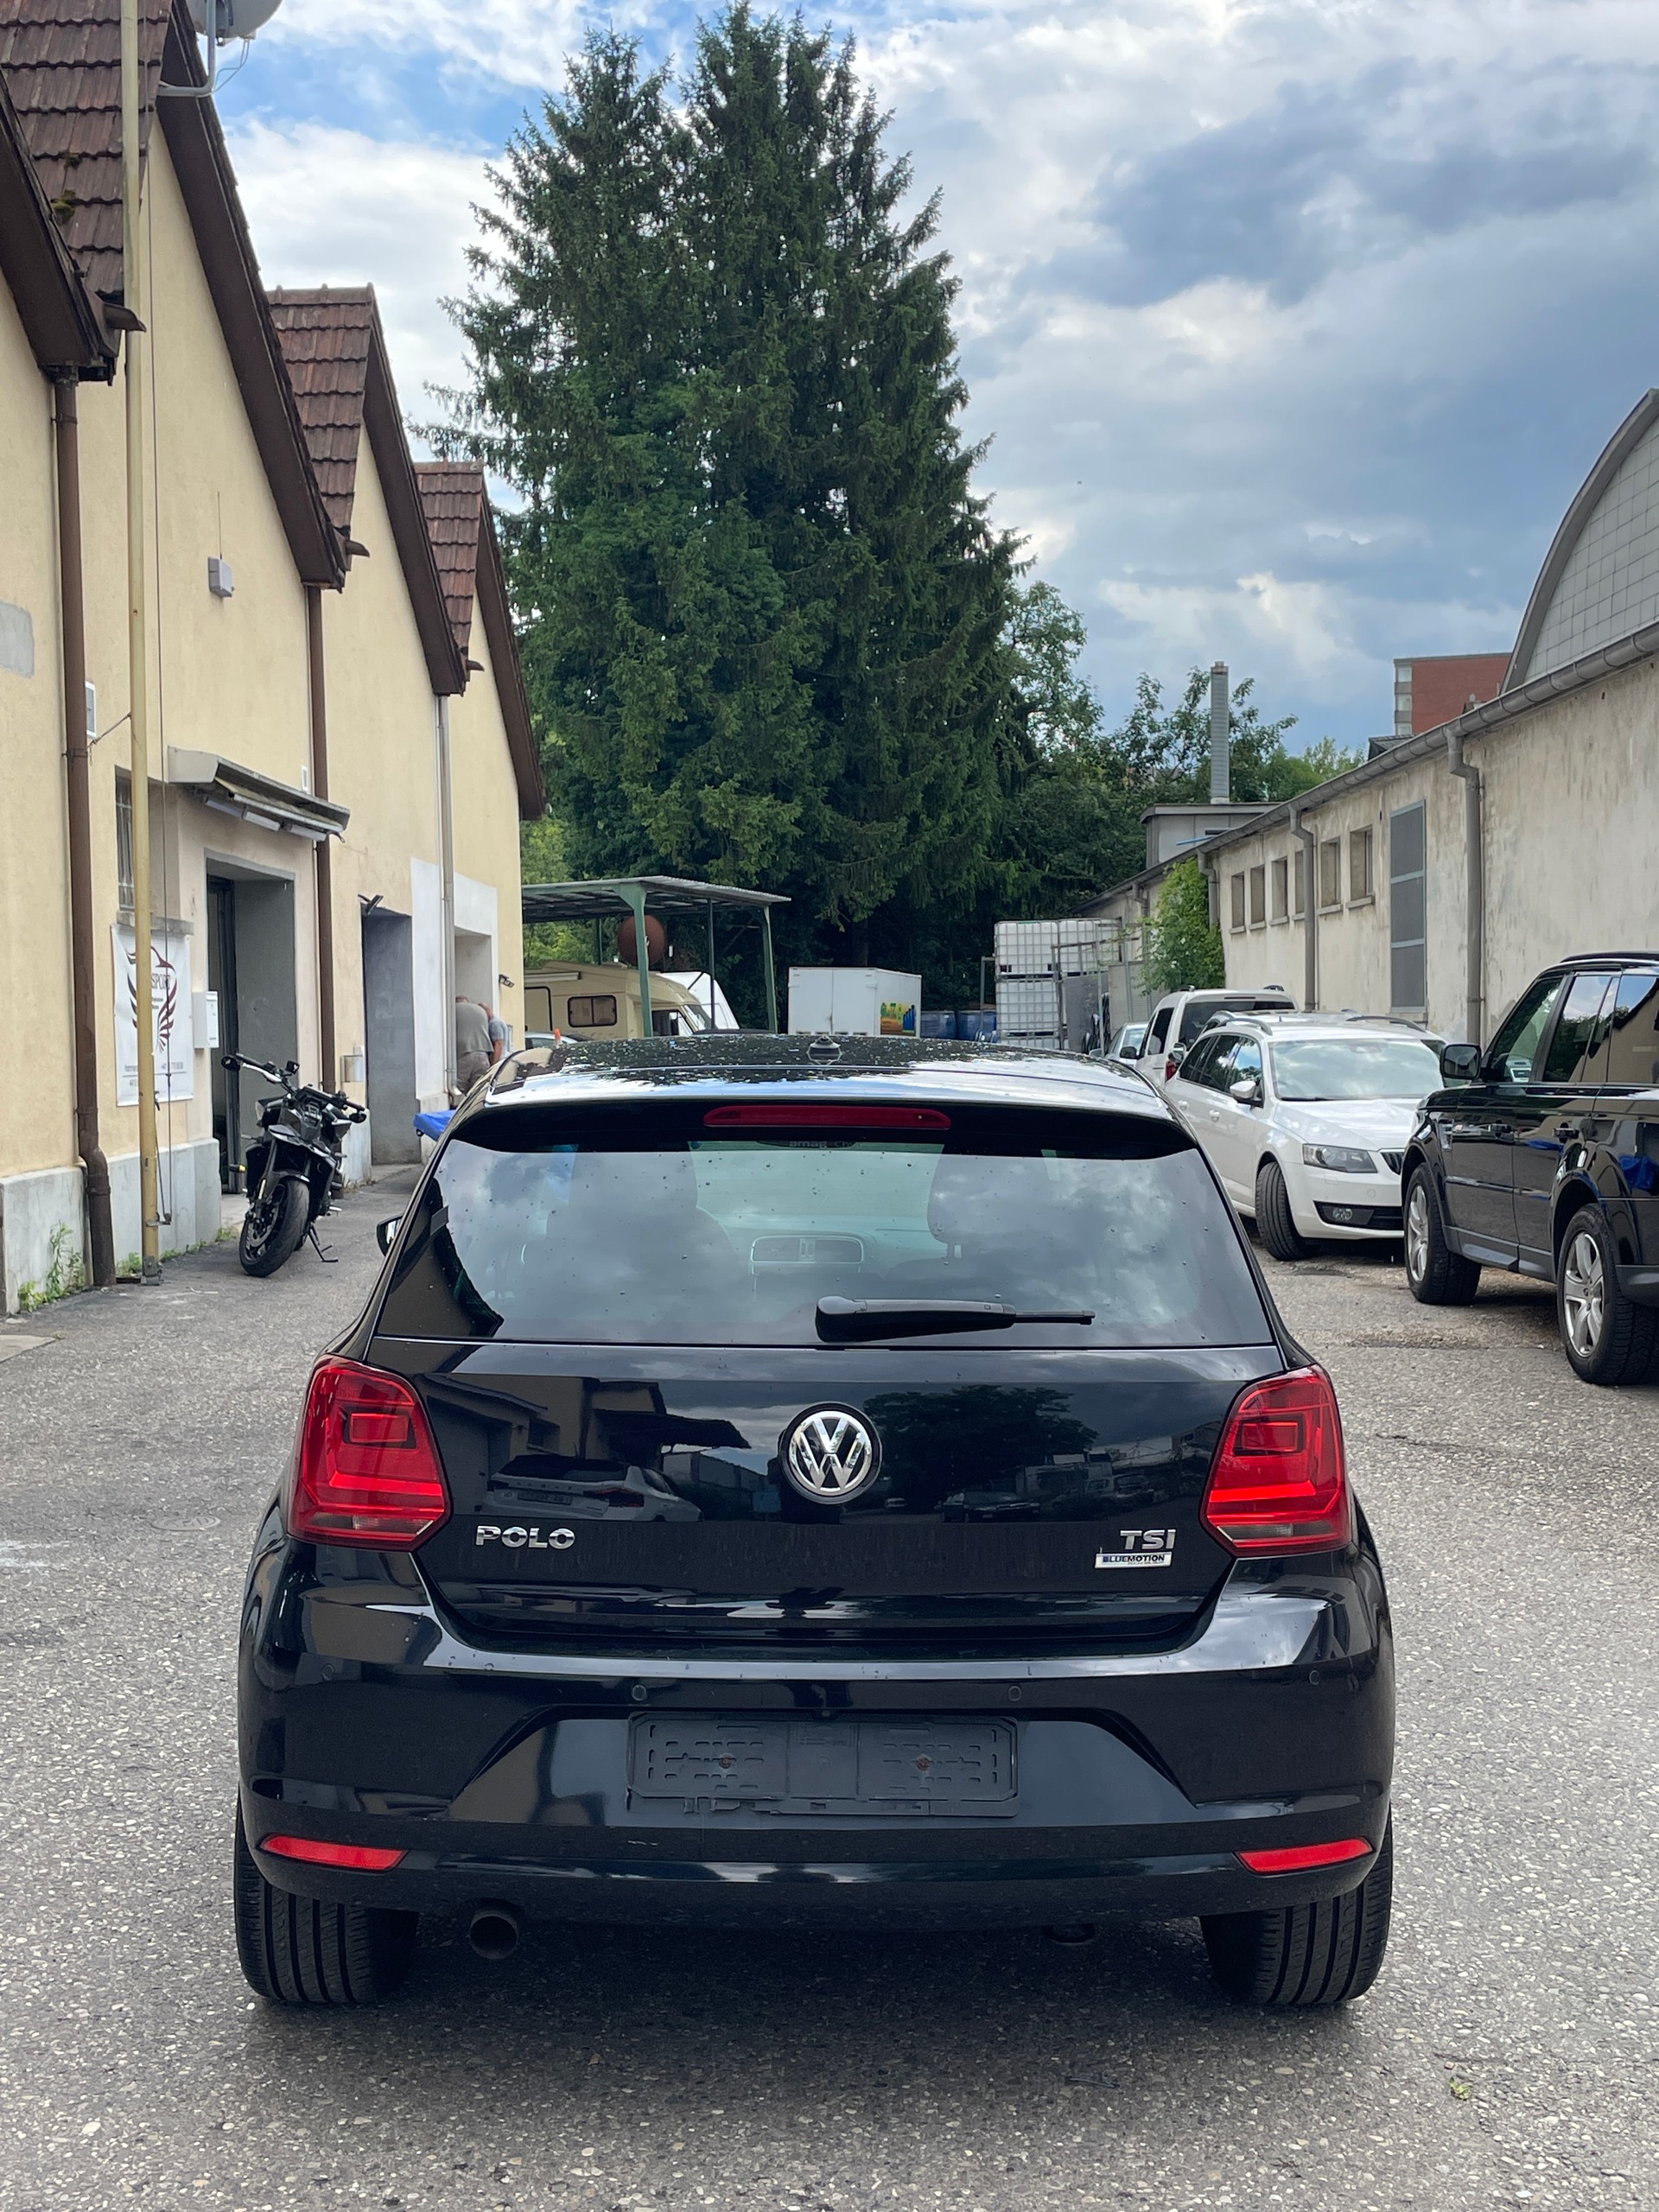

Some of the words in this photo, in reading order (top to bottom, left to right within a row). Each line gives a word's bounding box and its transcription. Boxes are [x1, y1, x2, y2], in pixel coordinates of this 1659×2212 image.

[789, 1411, 872, 1496] VW
[476, 1525, 575, 1549] POLO
[1120, 1529, 1176, 1550] TSI
[1103, 1554, 1165, 1563] BLUEMOTION
